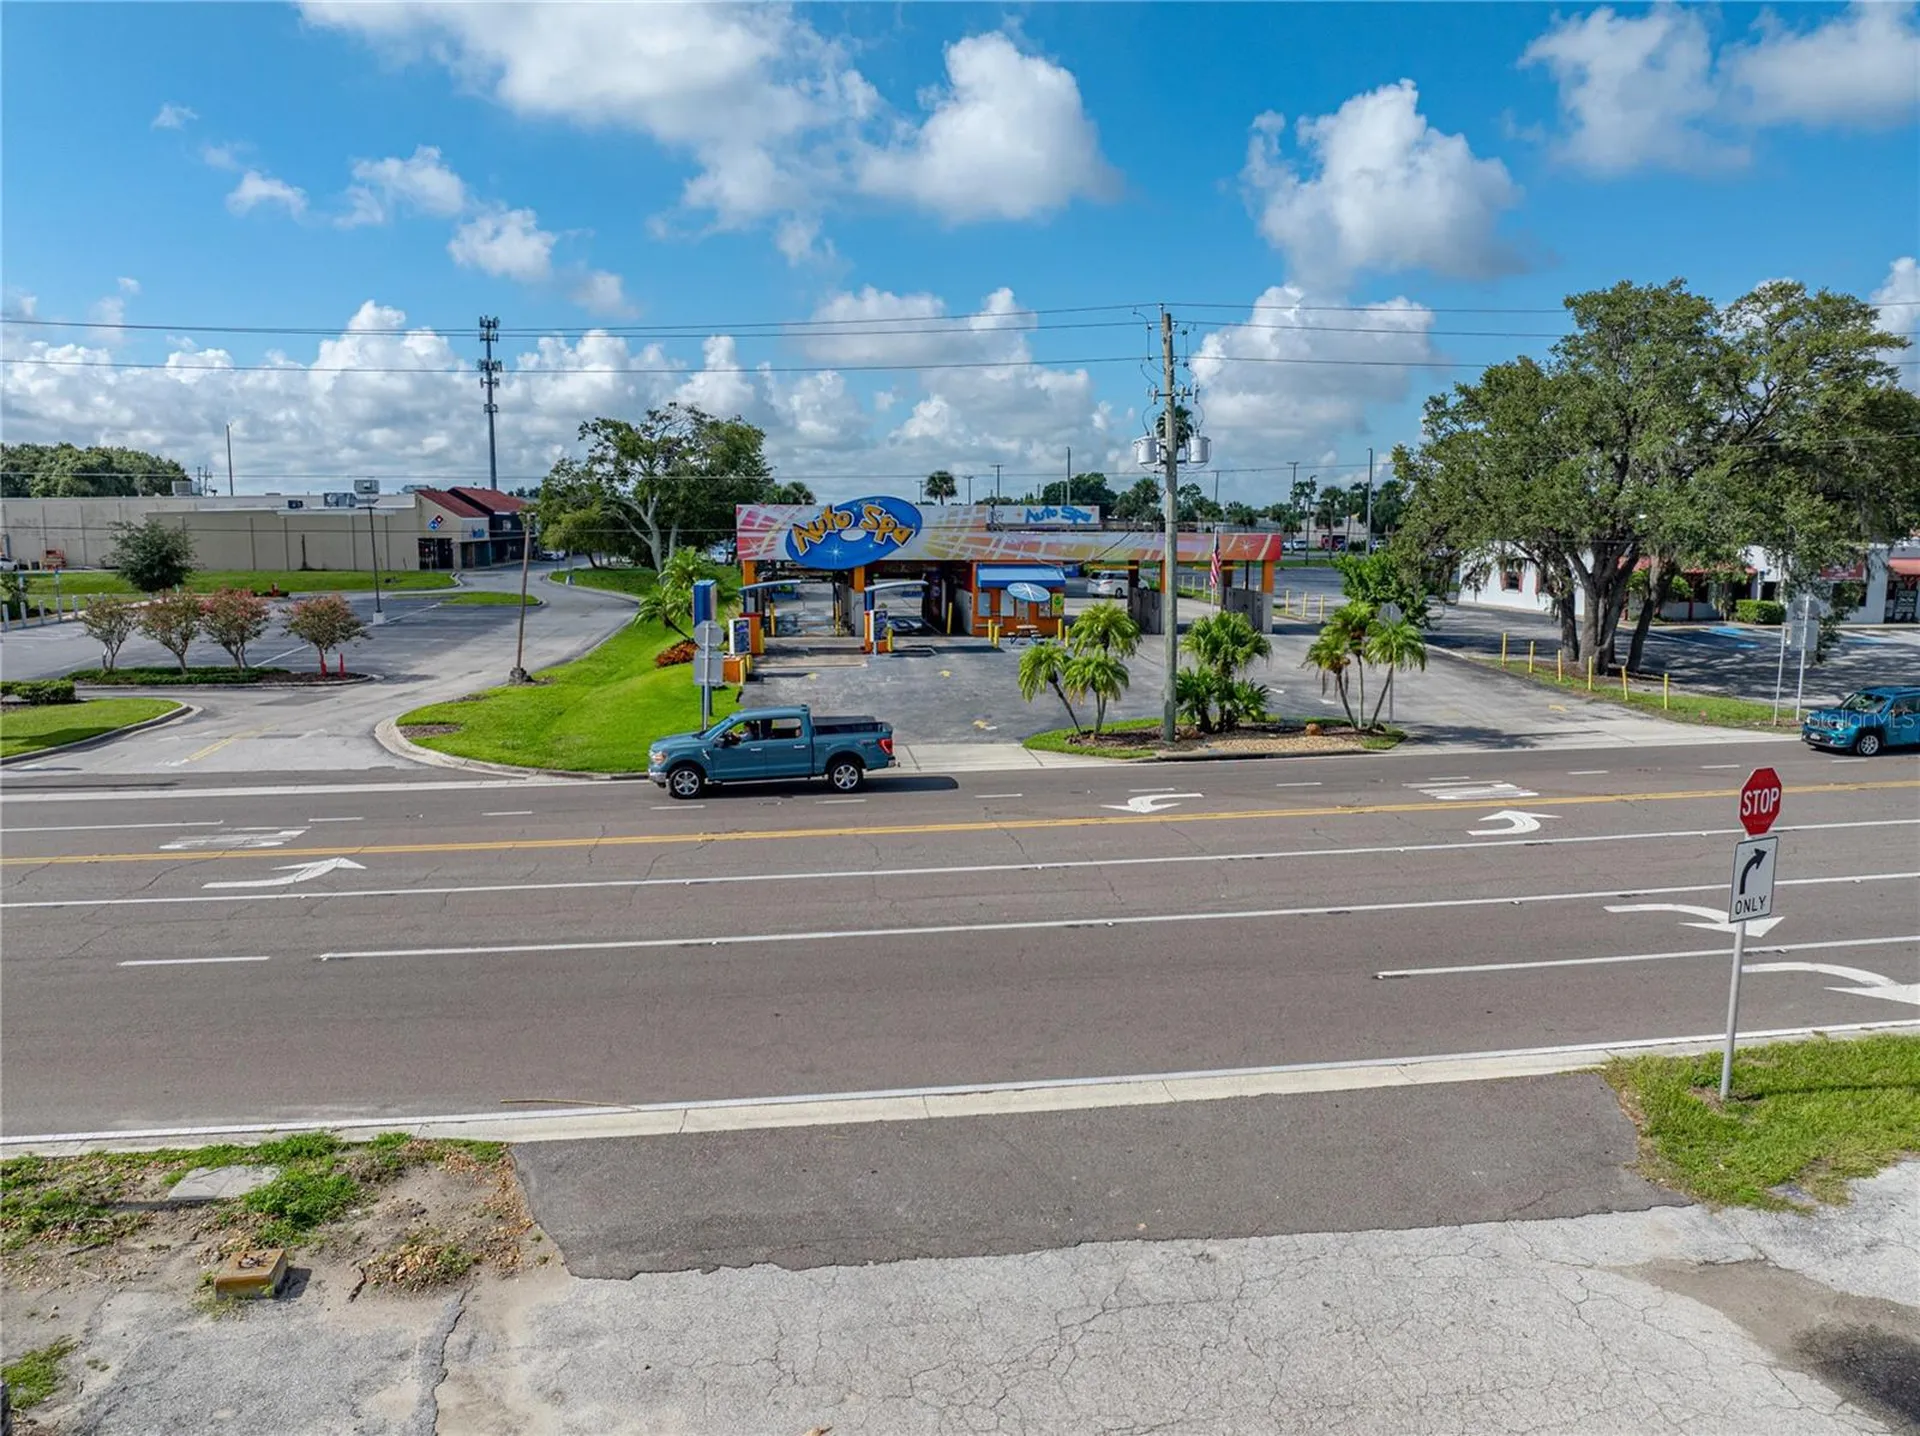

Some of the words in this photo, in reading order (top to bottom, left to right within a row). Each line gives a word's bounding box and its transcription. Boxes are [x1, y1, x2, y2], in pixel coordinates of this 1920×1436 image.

[1025, 505, 1058, 524] Auto
[792, 504, 854, 556] Auto
[860, 504, 916, 548] Spa
[1742, 787, 1780, 817] STOP
[1735, 895, 1767, 916] ONLY
